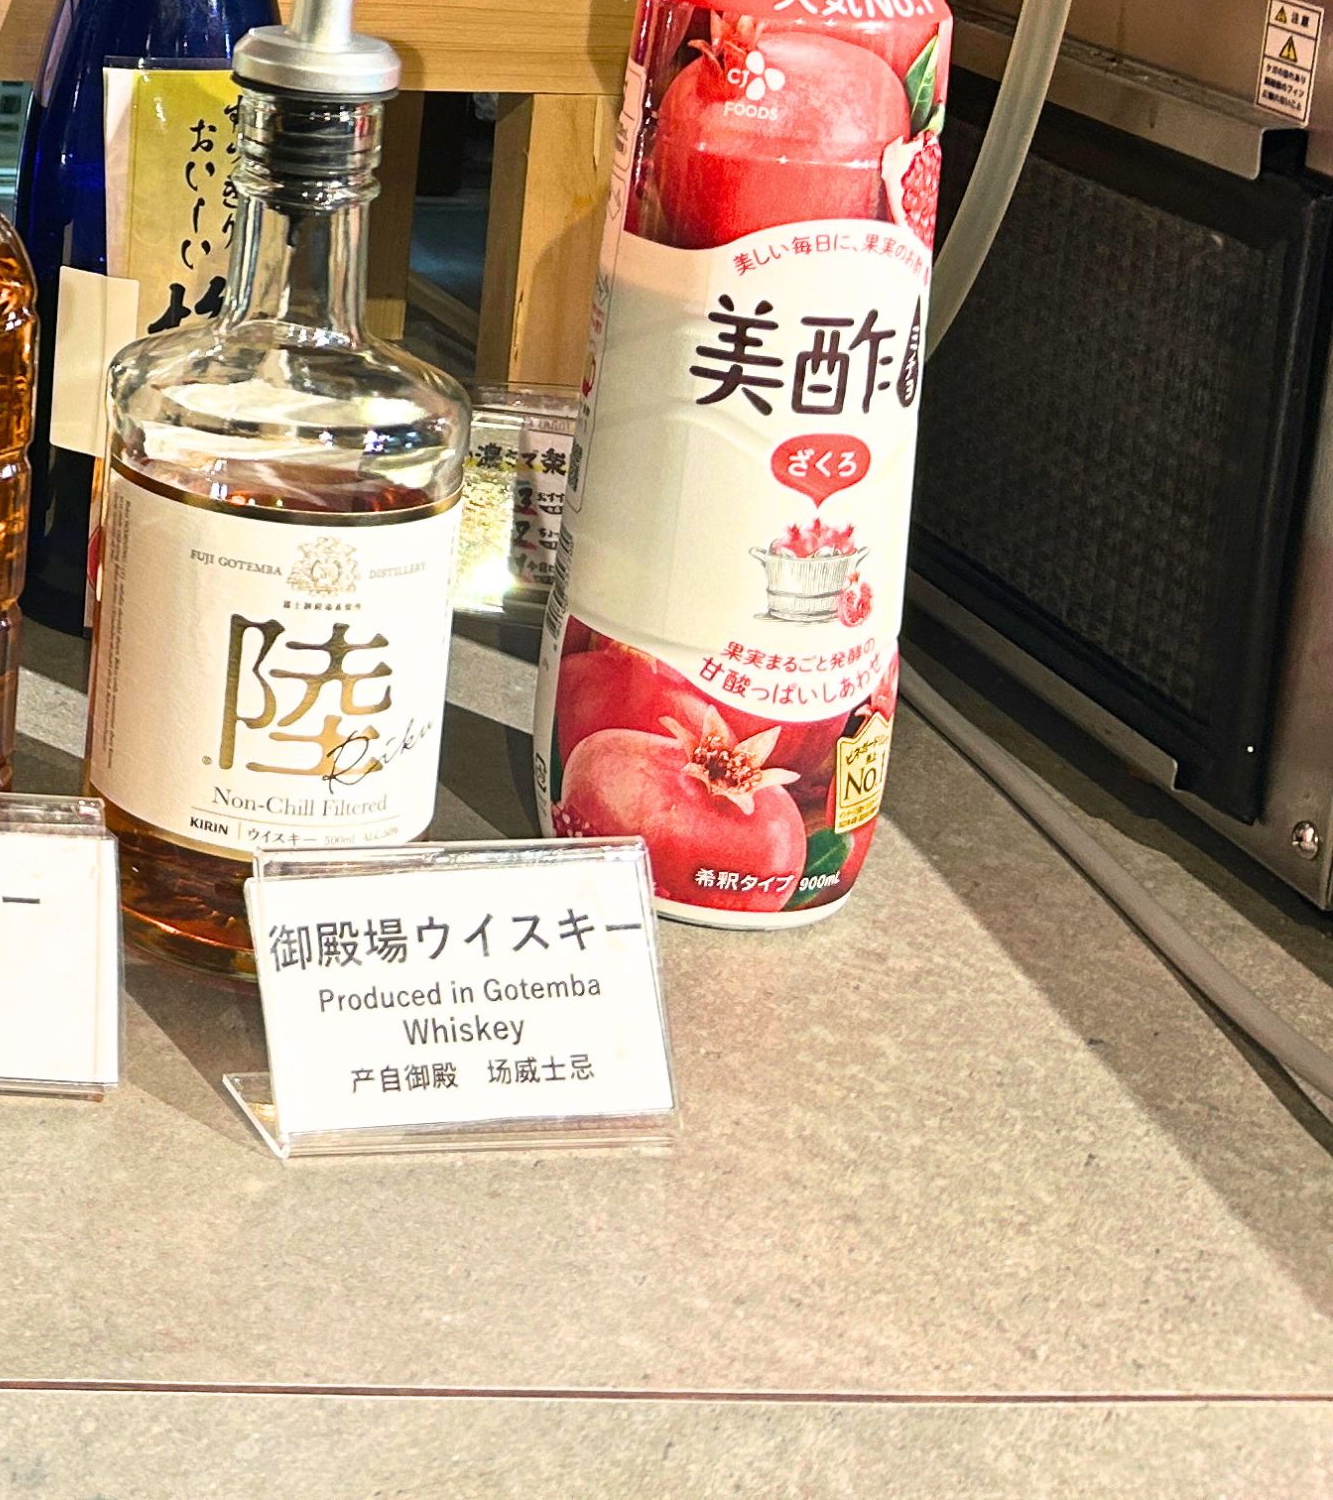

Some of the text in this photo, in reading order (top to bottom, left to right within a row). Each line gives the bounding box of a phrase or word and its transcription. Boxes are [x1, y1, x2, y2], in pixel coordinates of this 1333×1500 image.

[726, 67, 750, 87] CJ
[723, 102, 779, 122] FOODS
[689, 293, 896, 416] 美酢
[786, 448, 859, 478] ざくろ
[189, 549, 215, 566] FUJI
[218, 556, 283, 577] GOTEMBA
[720, 637, 876, 674] 果実まるごと発酵の
[219, 612, 393, 776] 陸
[698, 652, 883, 705] 甘酸っぱいしあわせ
[212, 785, 388, 817] Non-Chill Filtered
[189, 816, 229, 836] KIRIN
[248, 828, 318, 847] ウイスキー
[694, 867, 796, 893] 希釈タイプ
[267, 907, 643, 973] 御殿場ウイスキー
[318, 973, 602, 1012] Produced in Gotemba
[402, 1014, 525, 1047] Whiskey
[350, 1053, 596, 1094] 产自御殿 场威士忌
